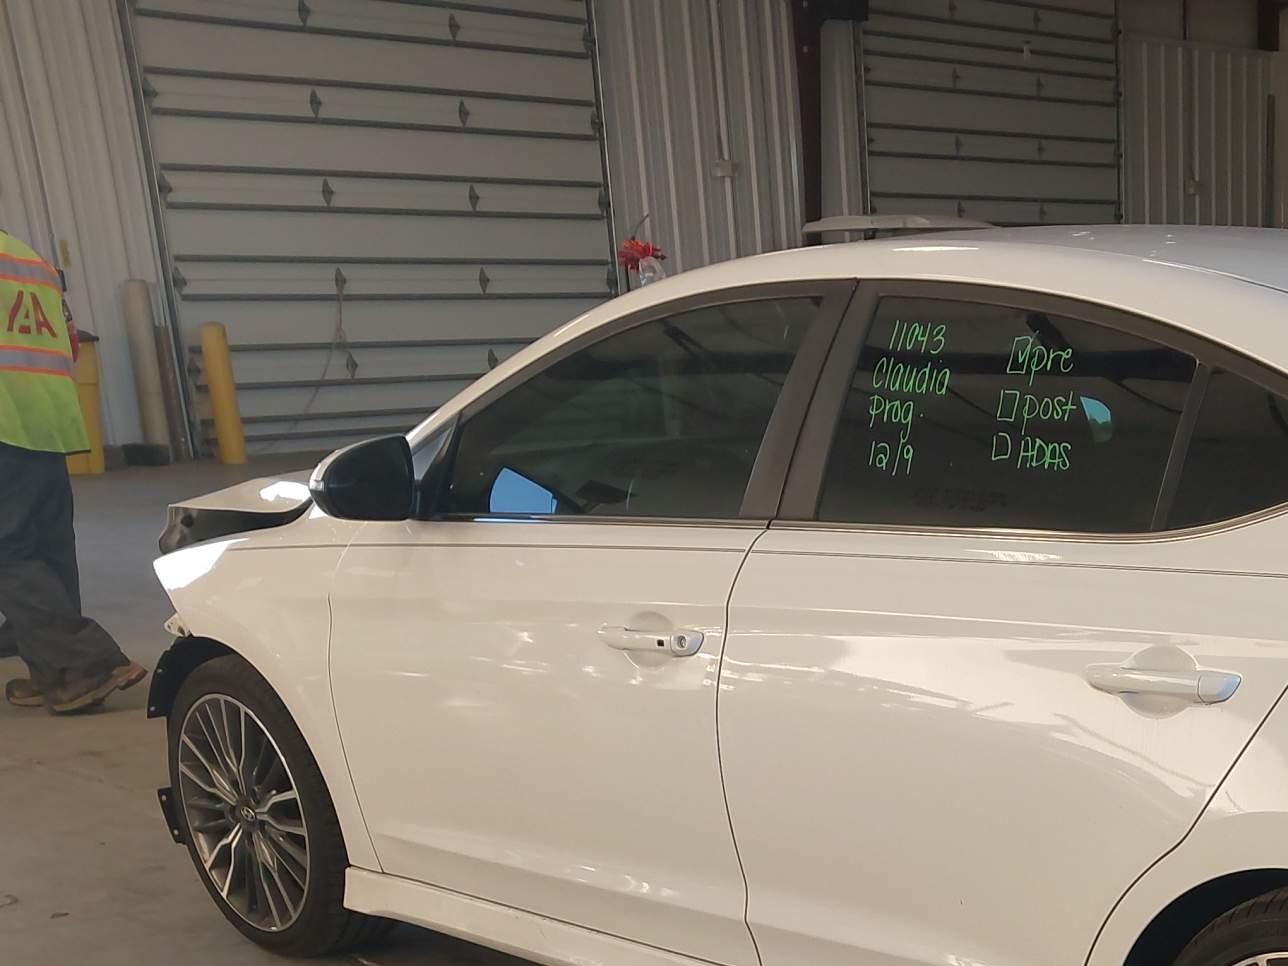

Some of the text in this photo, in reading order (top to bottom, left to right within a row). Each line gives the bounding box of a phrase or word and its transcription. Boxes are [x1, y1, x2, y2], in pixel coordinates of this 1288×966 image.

[889, 320, 946, 354] 11043
[872, 356, 950, 395] Claudia
[1022, 391, 1077, 435] post
[868, 431, 914, 476] 12/9
